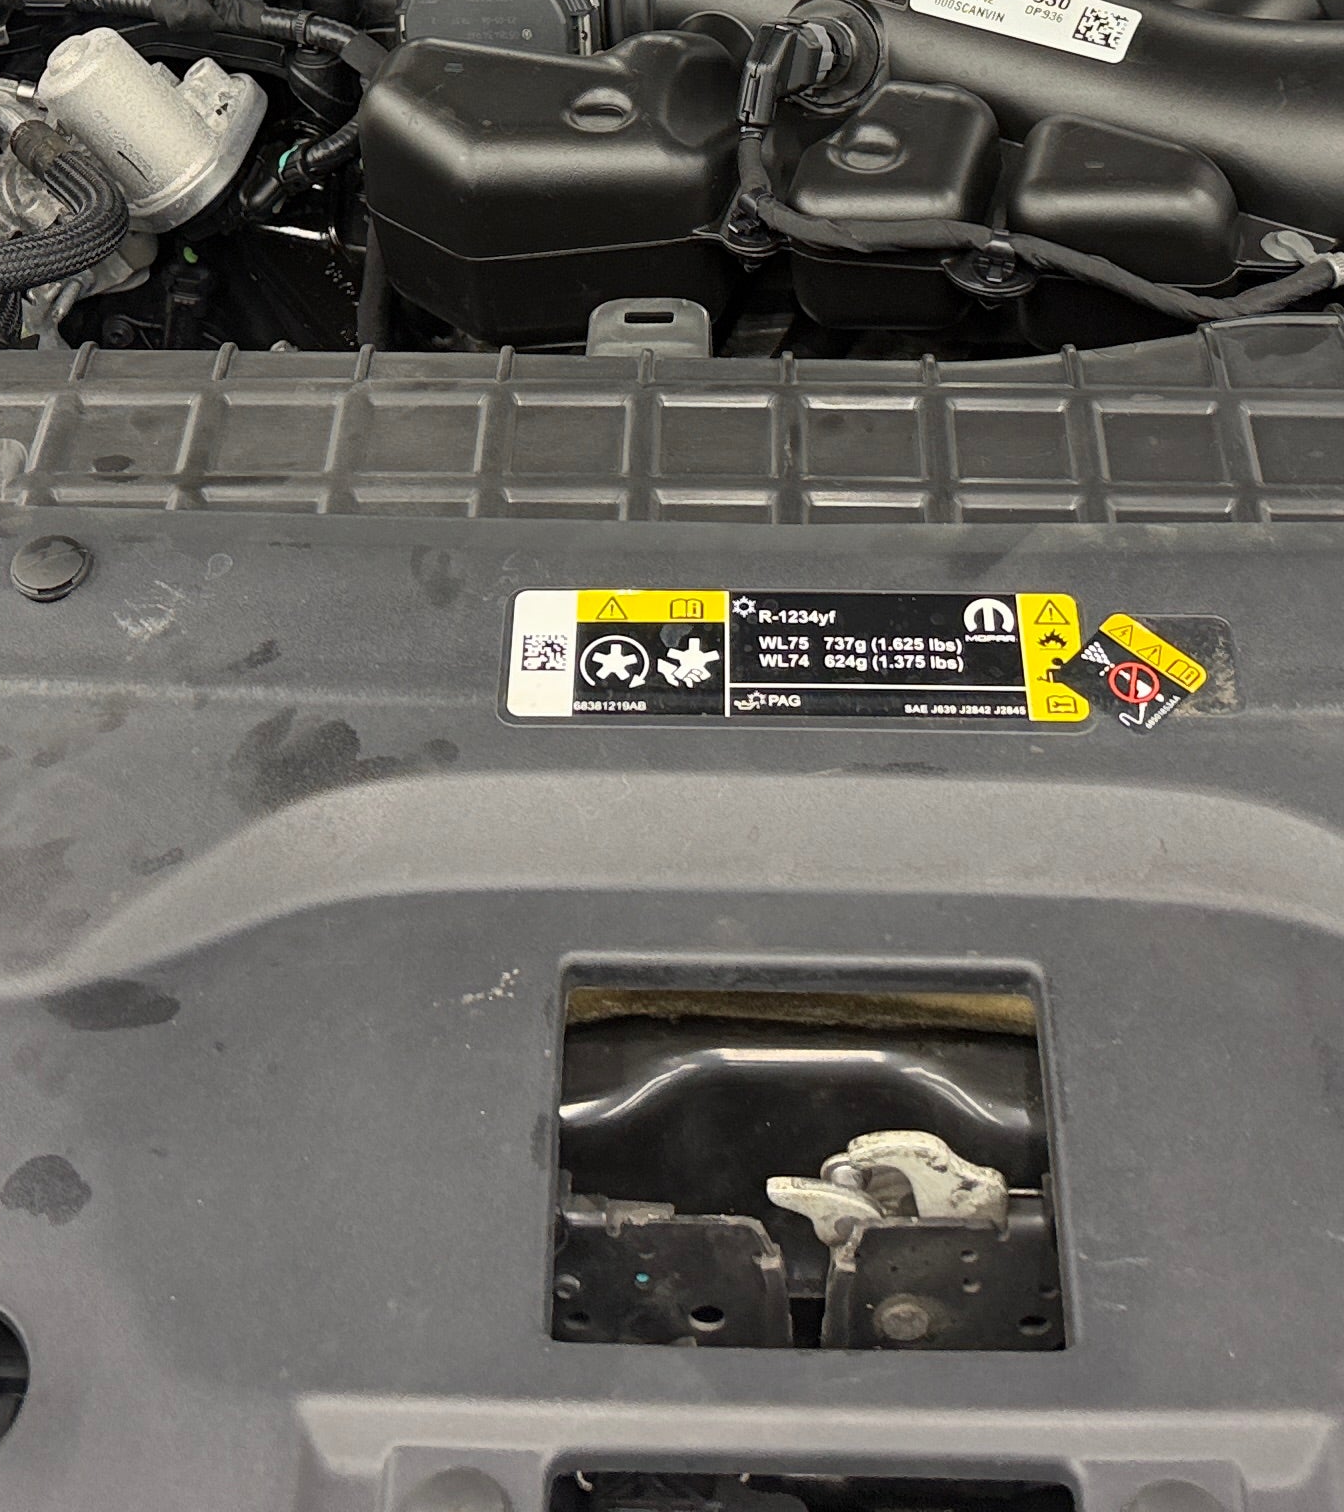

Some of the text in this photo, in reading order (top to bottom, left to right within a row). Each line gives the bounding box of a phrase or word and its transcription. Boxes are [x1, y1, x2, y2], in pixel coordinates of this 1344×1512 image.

[758, 609, 837, 627] R-1234yf
[758, 636, 964, 656] WL75 737g (1.625 lbs)
[758, 653, 965, 673] WL74 624g (1.375 lbs)
[573, 700, 647, 712] 68381219AB
[768, 694, 802, 708] PAG
[903, 704, 928, 714] SAE
[930, 704, 957, 715] J639
[958, 704, 992, 715] J2842
